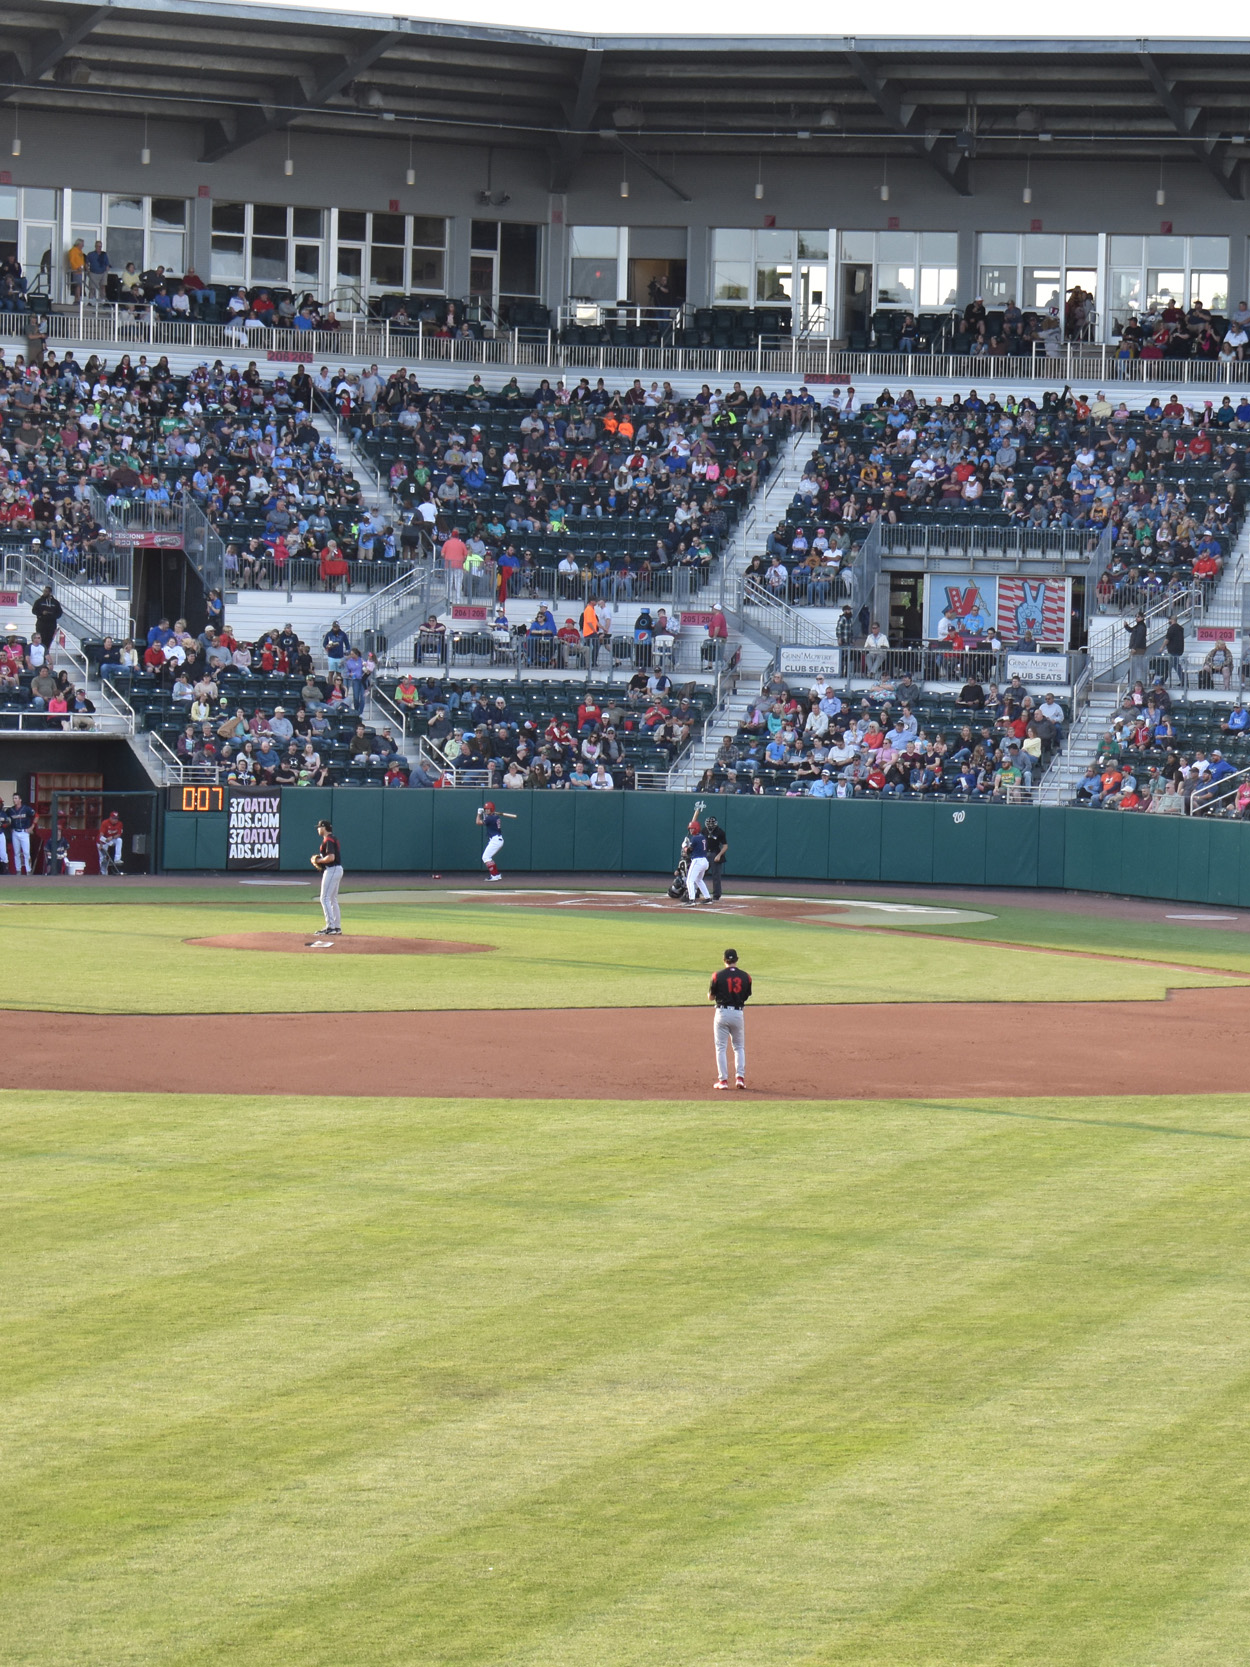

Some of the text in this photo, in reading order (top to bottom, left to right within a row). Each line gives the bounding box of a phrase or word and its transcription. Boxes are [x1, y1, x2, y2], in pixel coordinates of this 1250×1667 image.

[1219, 631, 1233, 639] 203
[809, 665, 835, 673] SEATS
[182, 787, 223, 811] 0:07
[229, 813, 280, 828] ADS.COM
[229, 844, 279, 858] ADS.COM
[726, 977, 743, 994] 13
